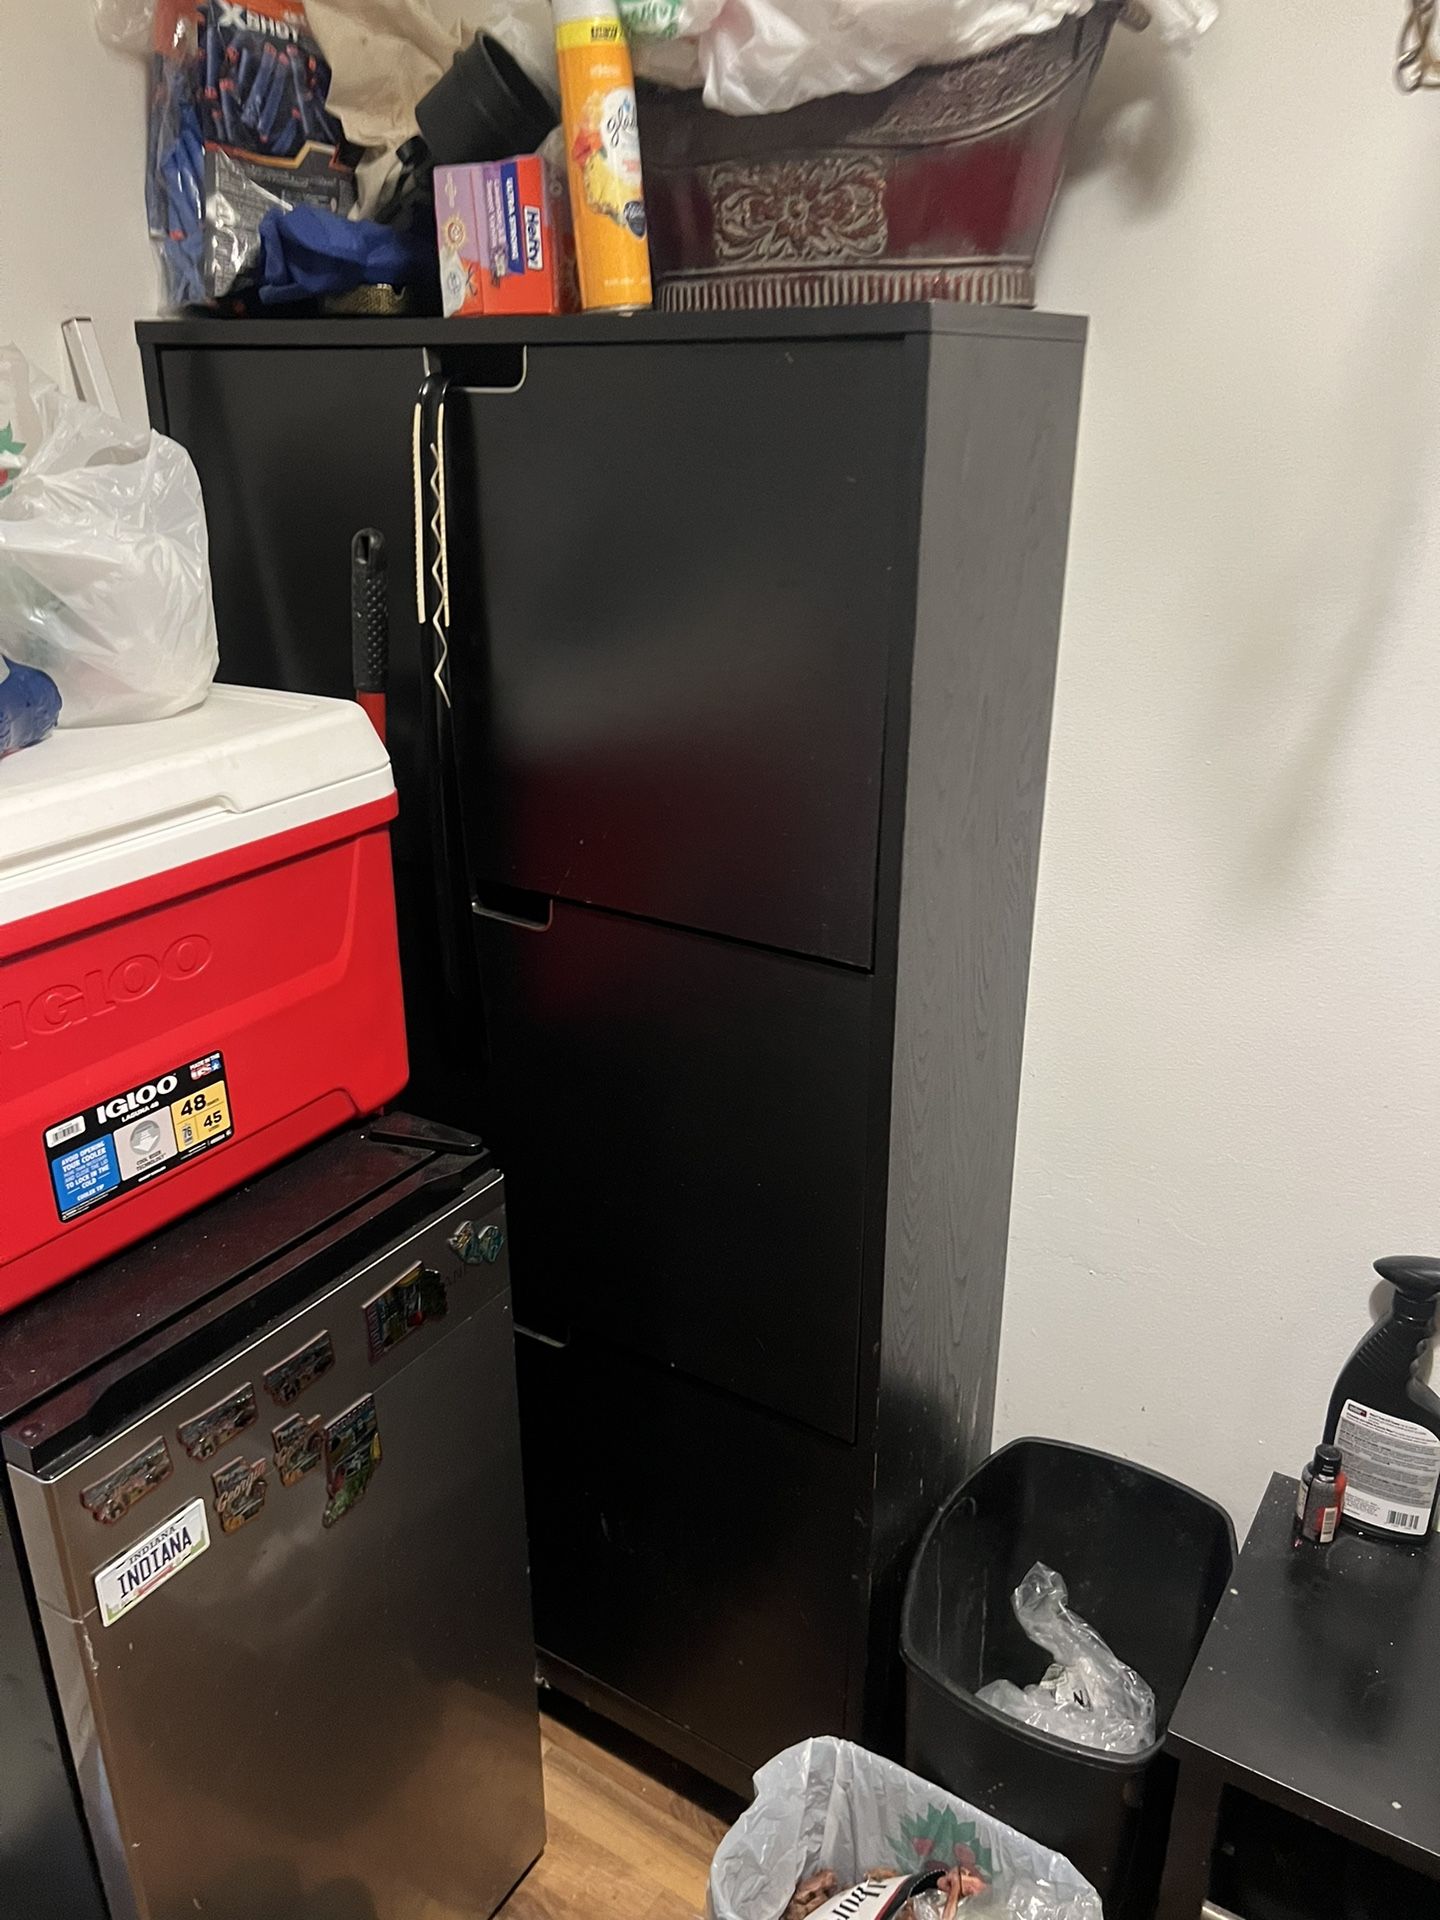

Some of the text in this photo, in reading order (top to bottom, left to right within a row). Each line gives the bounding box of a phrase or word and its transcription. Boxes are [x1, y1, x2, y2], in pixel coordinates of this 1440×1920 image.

[526, 210, 541, 262] Hefty
[0, 934, 213, 1050] IGLOO
[97, 1075, 178, 1125] IGLOO
[180, 1093, 207, 1117] 48
[203, 1110, 223, 1128] 45
[182, 1126, 193, 1139] 76
[62, 1147, 107, 1173] YOUR COOLER
[216, 1460, 267, 1513] Georgia
[116, 1525, 193, 1599] INDIANA
[128, 1525, 178, 1566] INDIANA
